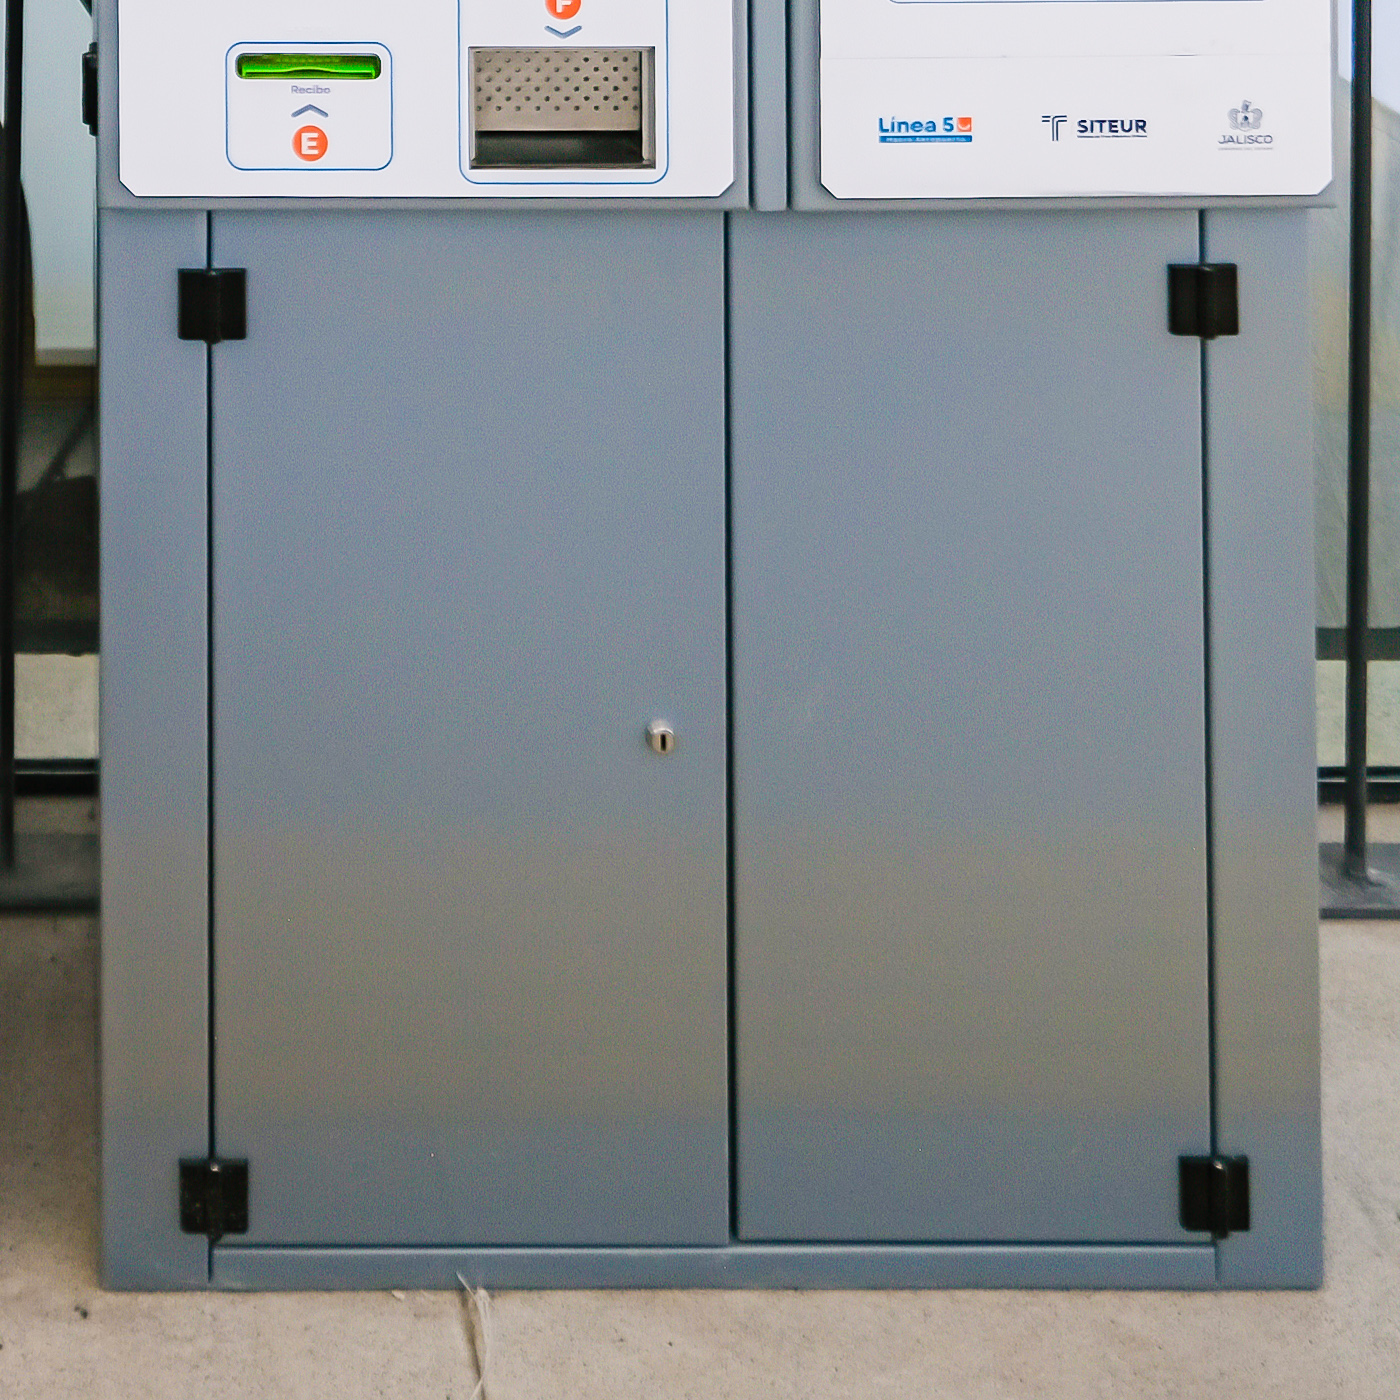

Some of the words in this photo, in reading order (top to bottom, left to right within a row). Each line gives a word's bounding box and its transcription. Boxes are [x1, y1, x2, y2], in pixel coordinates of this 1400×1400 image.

[291, 85, 331, 94] Recibo
[943, 117, 954, 132] 5
[1077, 119, 1146, 133] SITEUR
[301, 133, 320, 154] E
[1218, 135, 1273, 144] JALISCO
